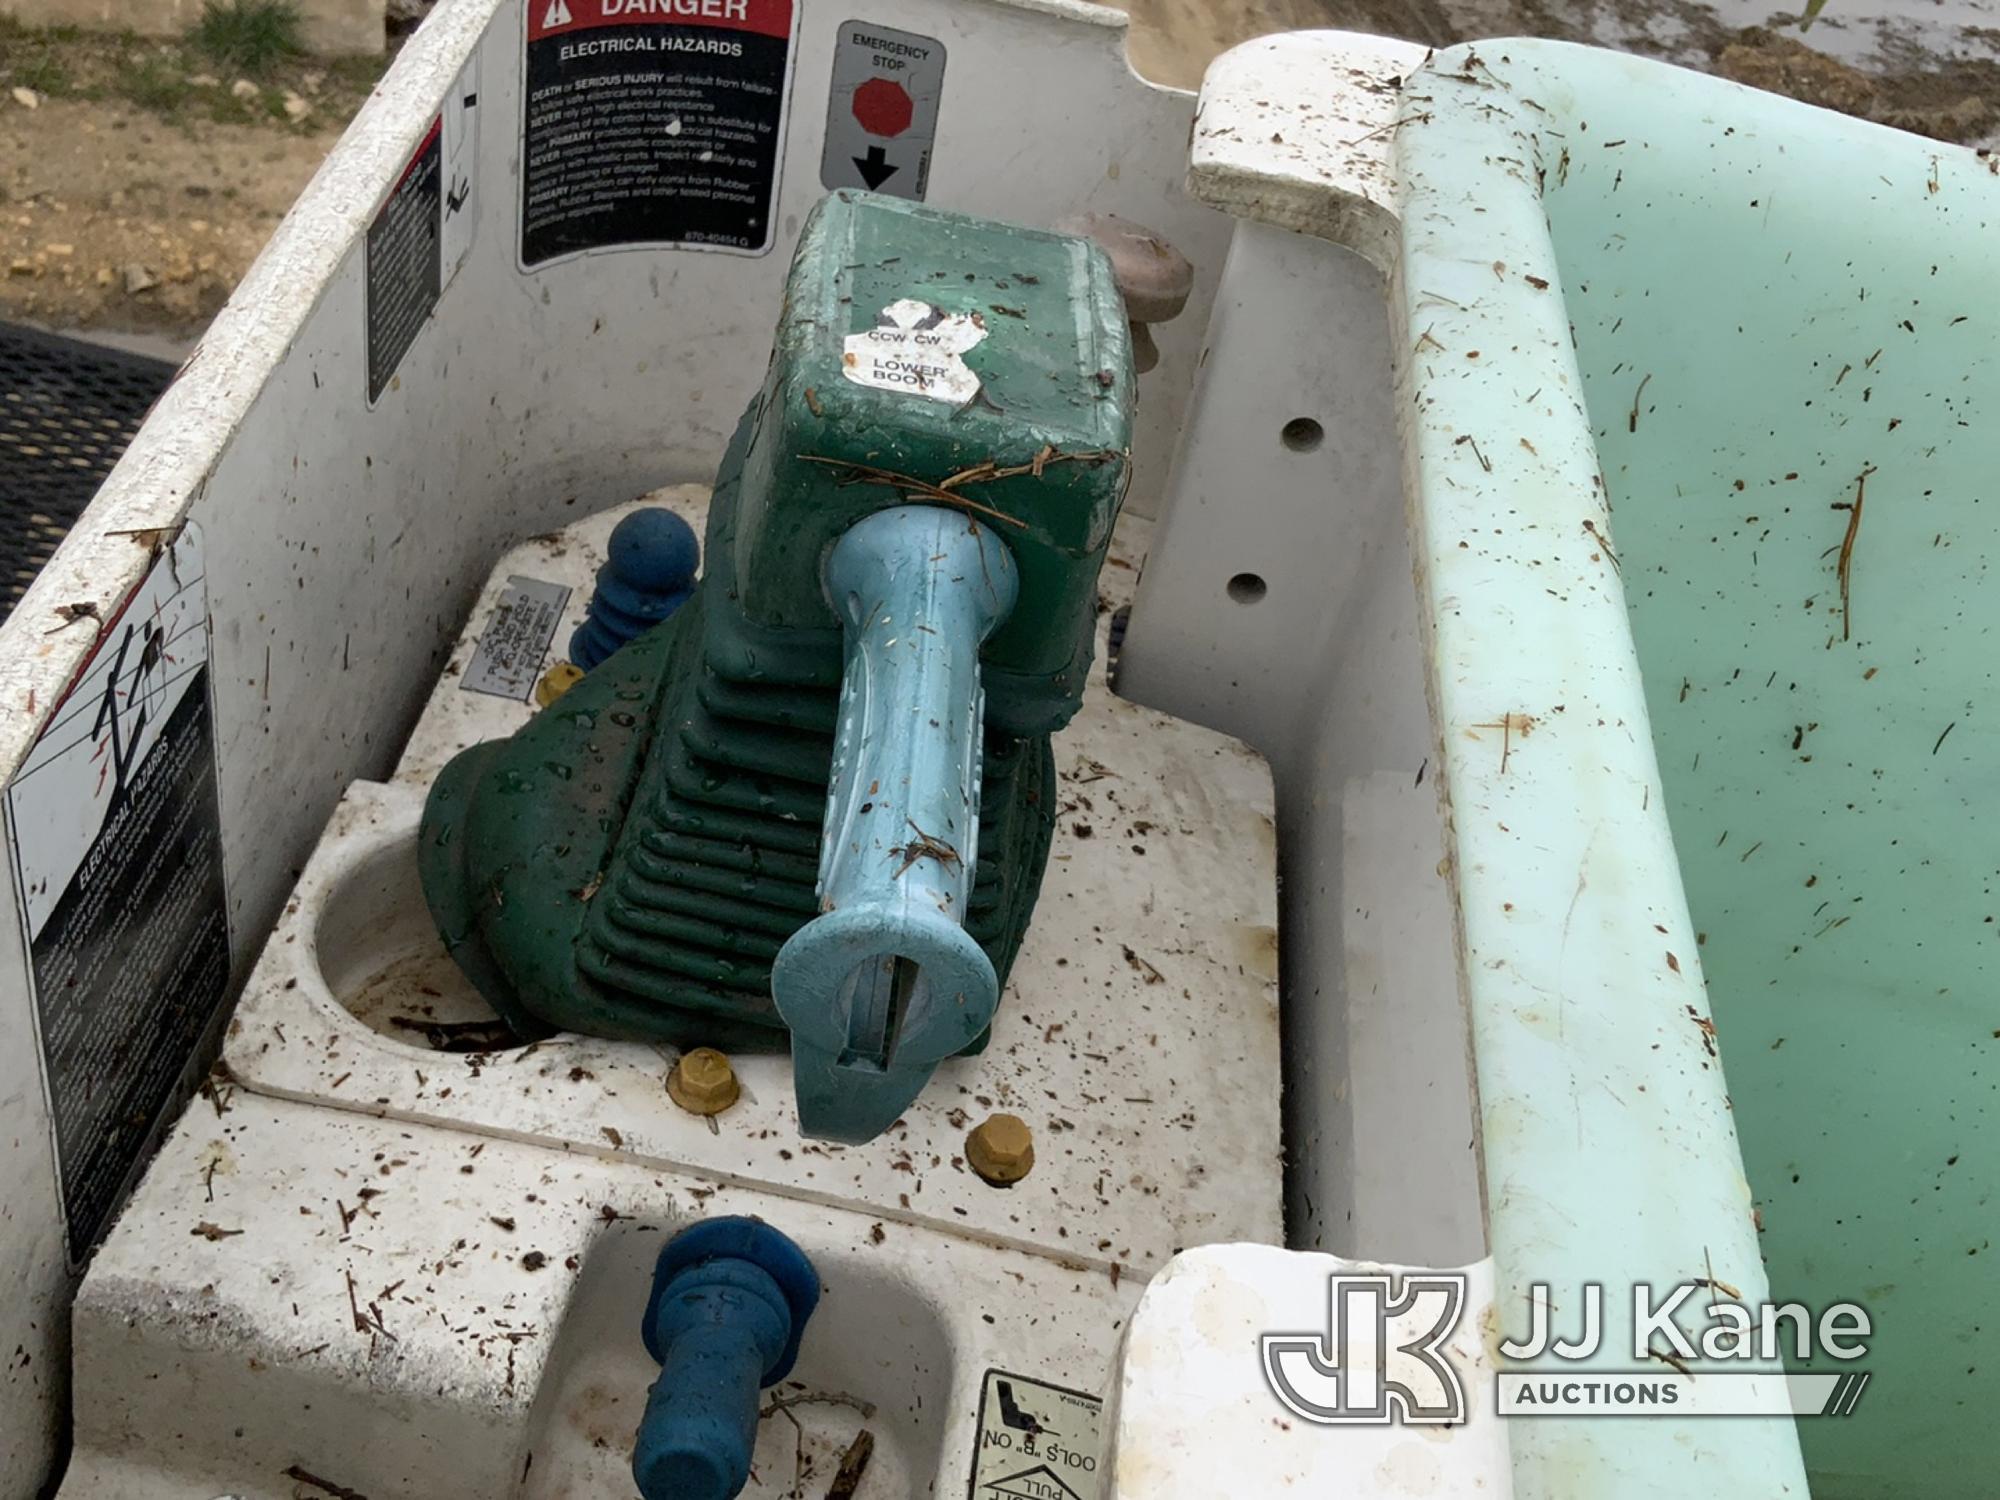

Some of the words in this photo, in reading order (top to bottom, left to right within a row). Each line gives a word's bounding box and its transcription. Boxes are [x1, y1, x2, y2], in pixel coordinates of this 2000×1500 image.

[601, 0, 747, 20] DANGER
[560, 38, 656, 60] ELECTRICAL
[660, 38, 743, 57] HAZARDS
[853, 33, 930, 60] EMERGENCY
[872, 56, 905, 71] STOP
[532, 85, 562, 102] DEATH
[575, 75, 622, 91] SERIOUS
[623, 73, 664, 84] INJURY
[685, 75, 713, 85] result
[716, 77, 739, 89] from
[587, 88, 630, 101] electrical
[631, 88, 654, 96] work
[617, 101, 661, 111] electrical
[663, 101, 715, 112] resistance
[612, 114, 645, 124] control
[708, 116, 756, 130] substitute
[549, 131, 593, 149] PRIMARY
[594, 129, 642, 139] protection
[688, 175, 712, 185] from
[714, 177, 750, 191] Rubber
[680, 187, 711, 198] tested
[712, 190, 756, 204] personal
[868, 330, 907, 343] CCW
[914, 334, 941, 346] CW
[873, 358, 947, 379] LOWER
[873, 370, 935, 389] BOOM
[79, 804, 131, 890] ELECTRICAL
[983, 1429, 1012, 1449] ON
